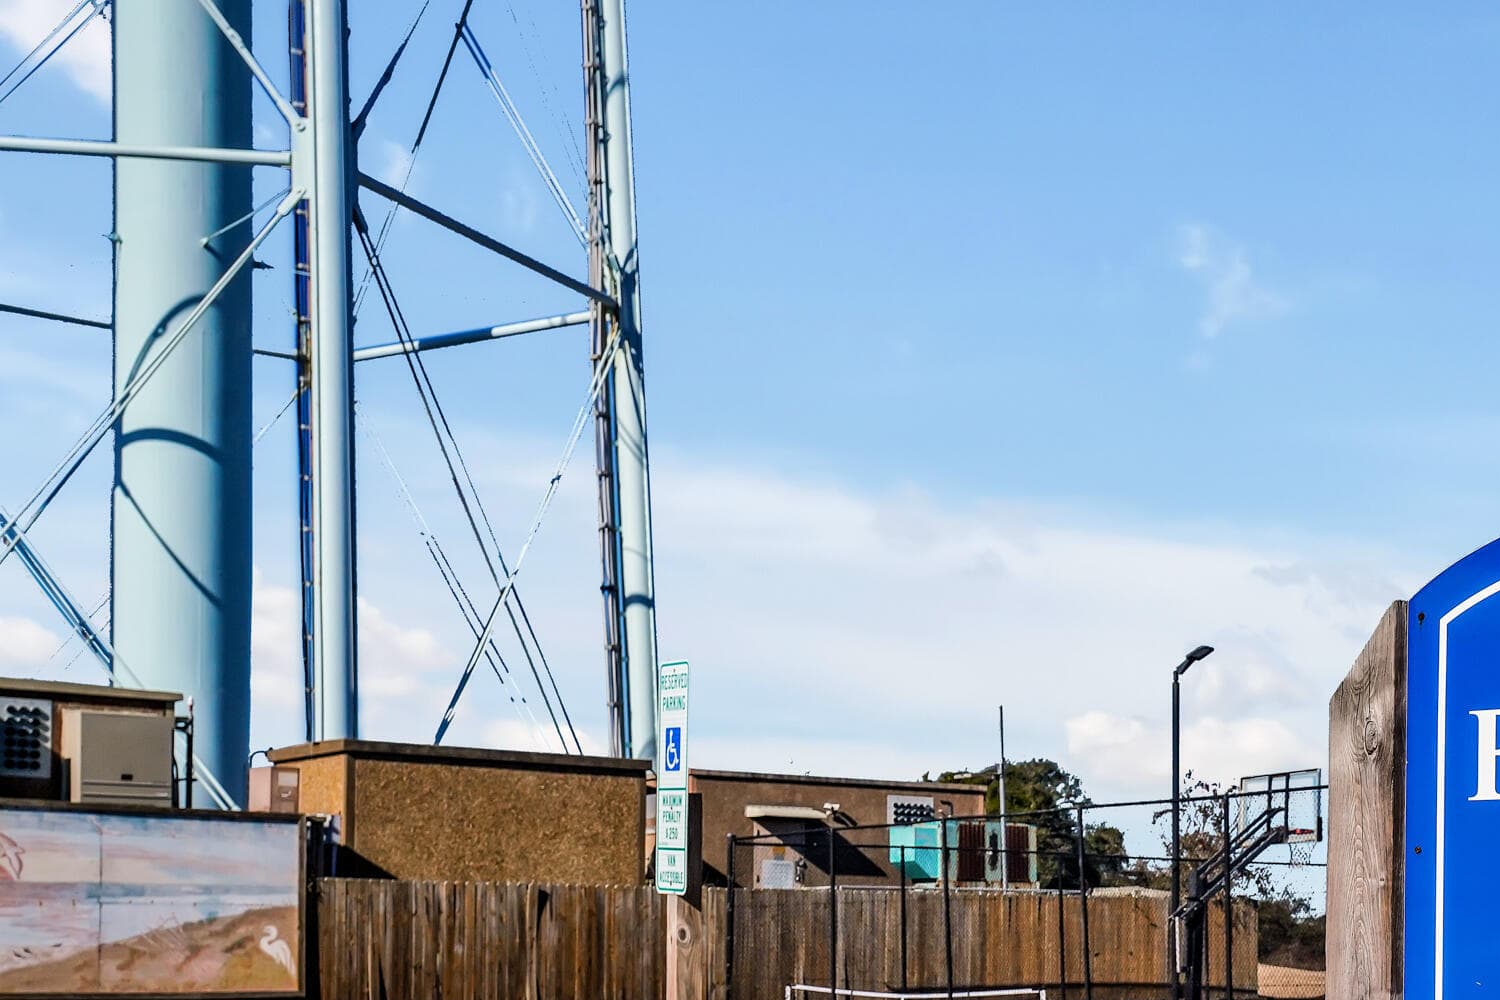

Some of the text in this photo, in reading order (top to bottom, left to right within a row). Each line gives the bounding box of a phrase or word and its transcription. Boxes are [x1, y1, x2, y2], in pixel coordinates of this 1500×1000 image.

[660, 673, 687, 690] RESERVED
[663, 695, 685, 711] PARKING
[662, 795, 682, 806] MAXIMUM
[663, 810, 681, 822] PENALTY
